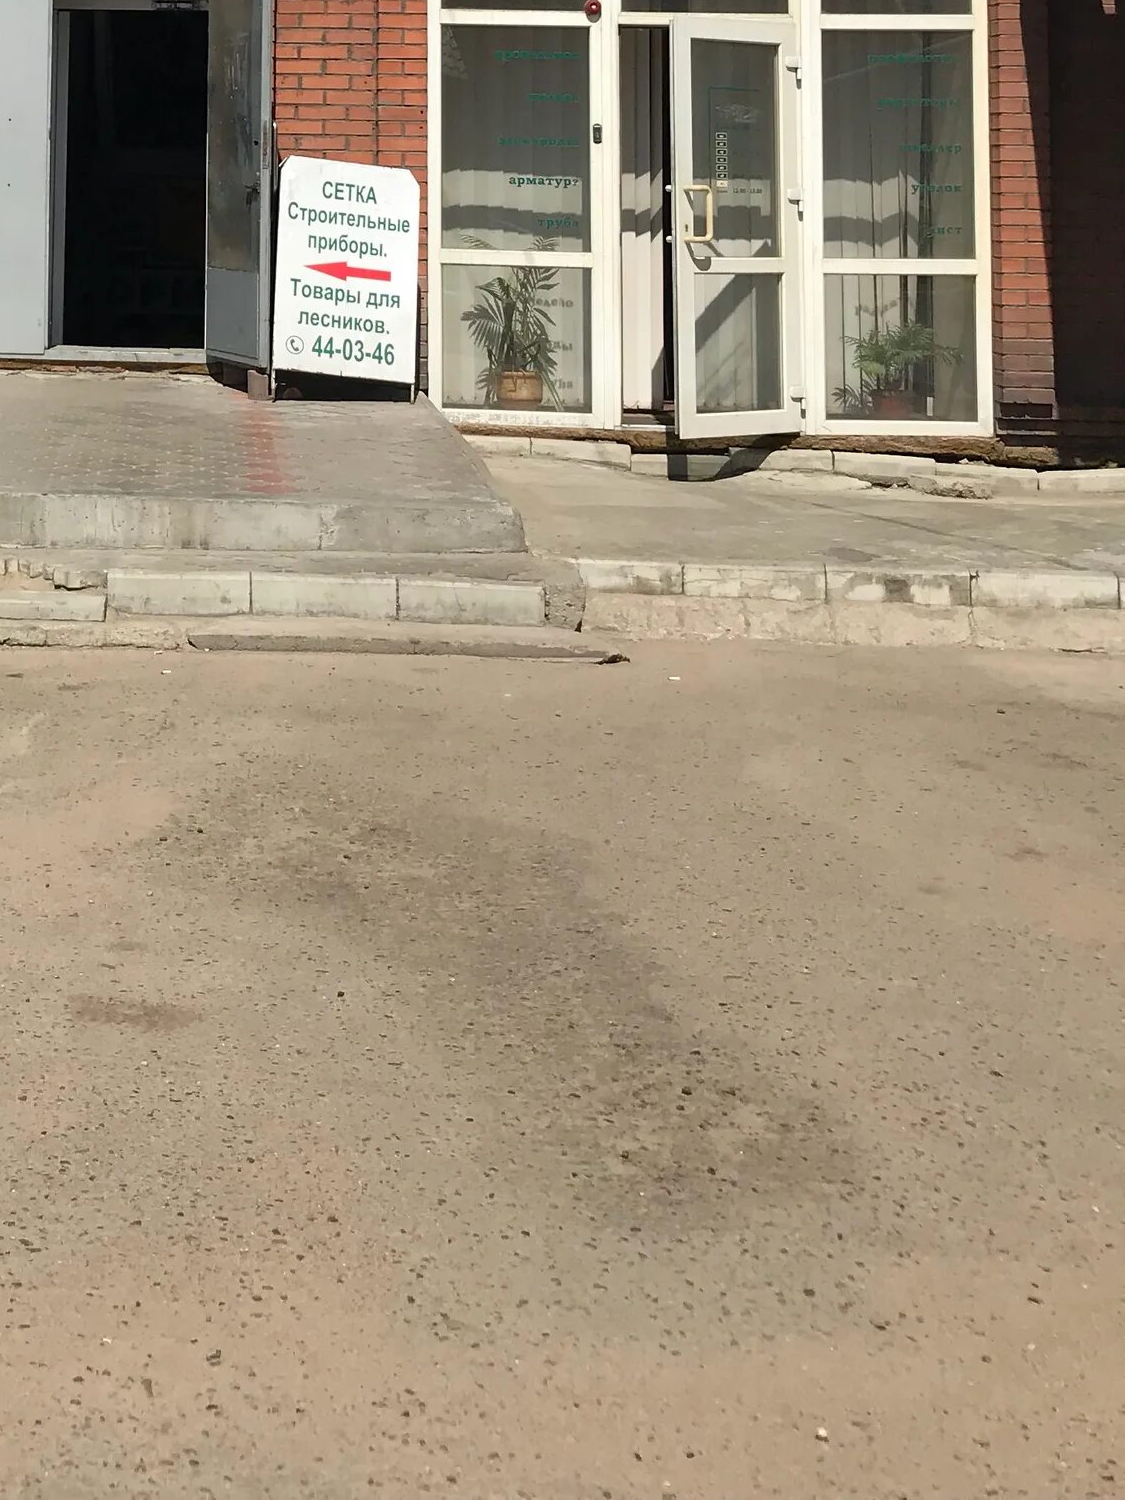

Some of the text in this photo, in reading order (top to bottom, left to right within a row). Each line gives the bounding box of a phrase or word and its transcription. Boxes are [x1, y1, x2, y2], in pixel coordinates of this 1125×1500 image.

[322, 181, 377, 204] СЕТКА
[288, 202, 410, 233] Строительные
[308, 234, 387, 258] приборы.
[290, 278, 401, 309] Товары для
[298, 310, 390, 334] лесников.
[312, 335, 395, 366] 44-03-46
